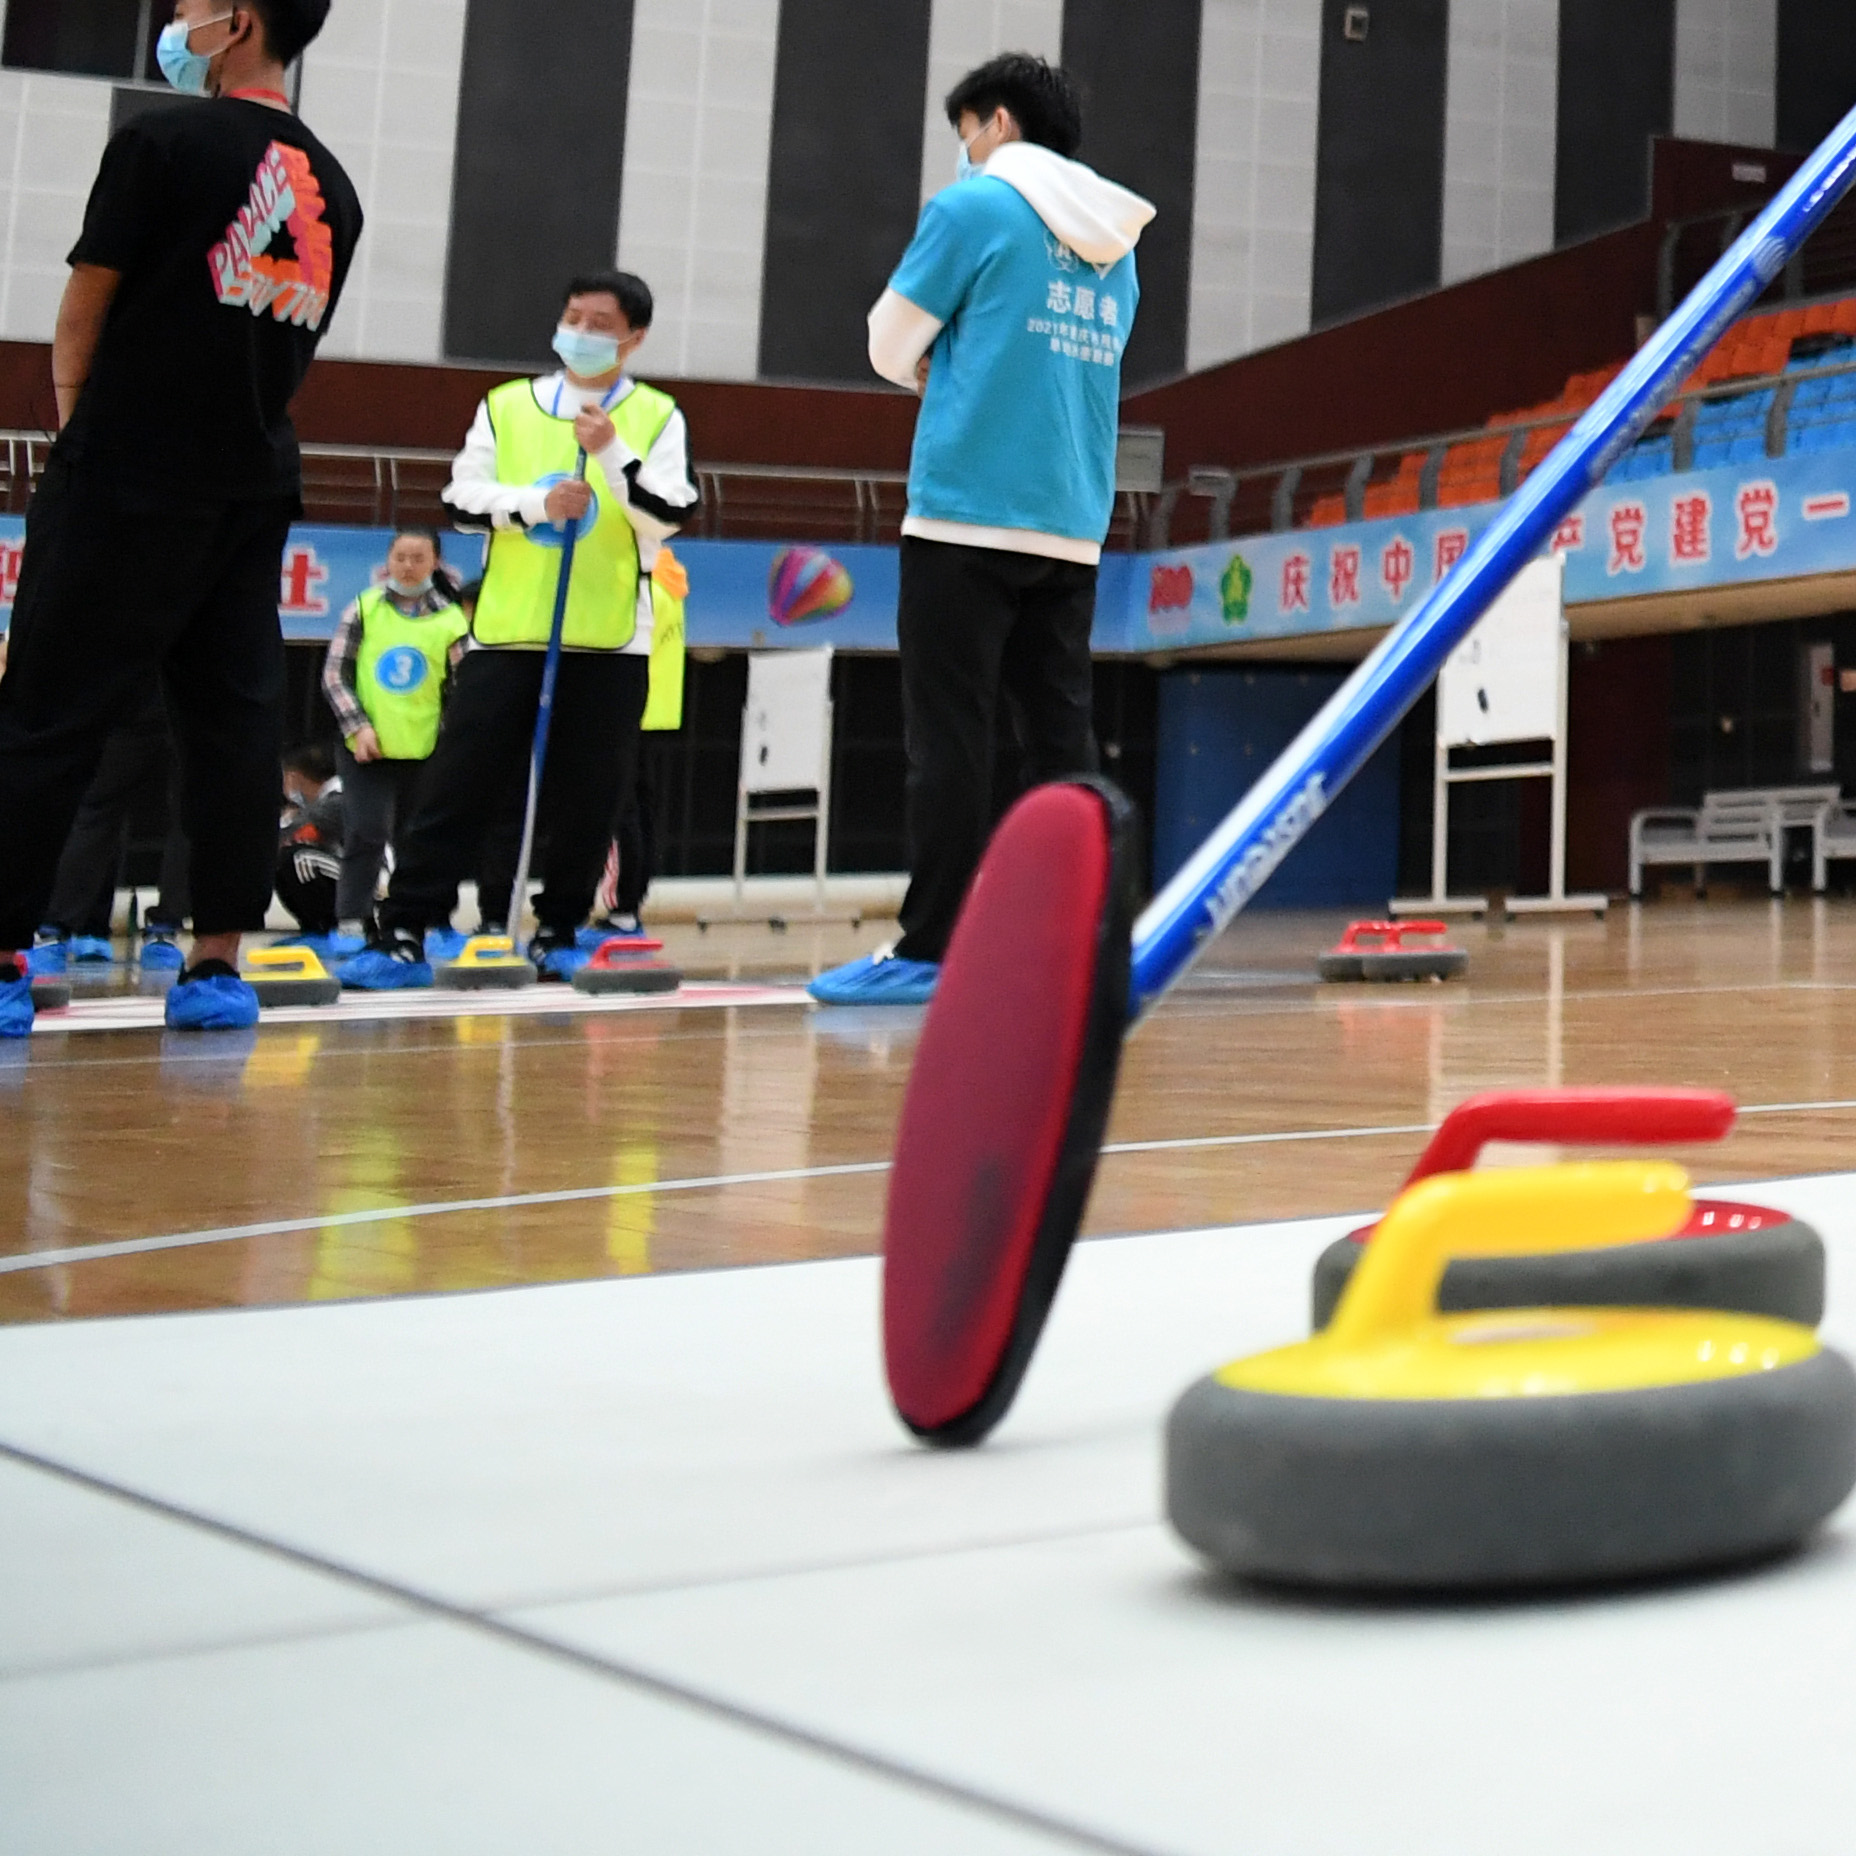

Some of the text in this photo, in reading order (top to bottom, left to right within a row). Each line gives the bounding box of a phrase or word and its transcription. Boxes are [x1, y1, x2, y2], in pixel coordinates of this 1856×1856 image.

[1047, 280, 1118, 326] 志愿者
[390, 654, 412, 686] 3
